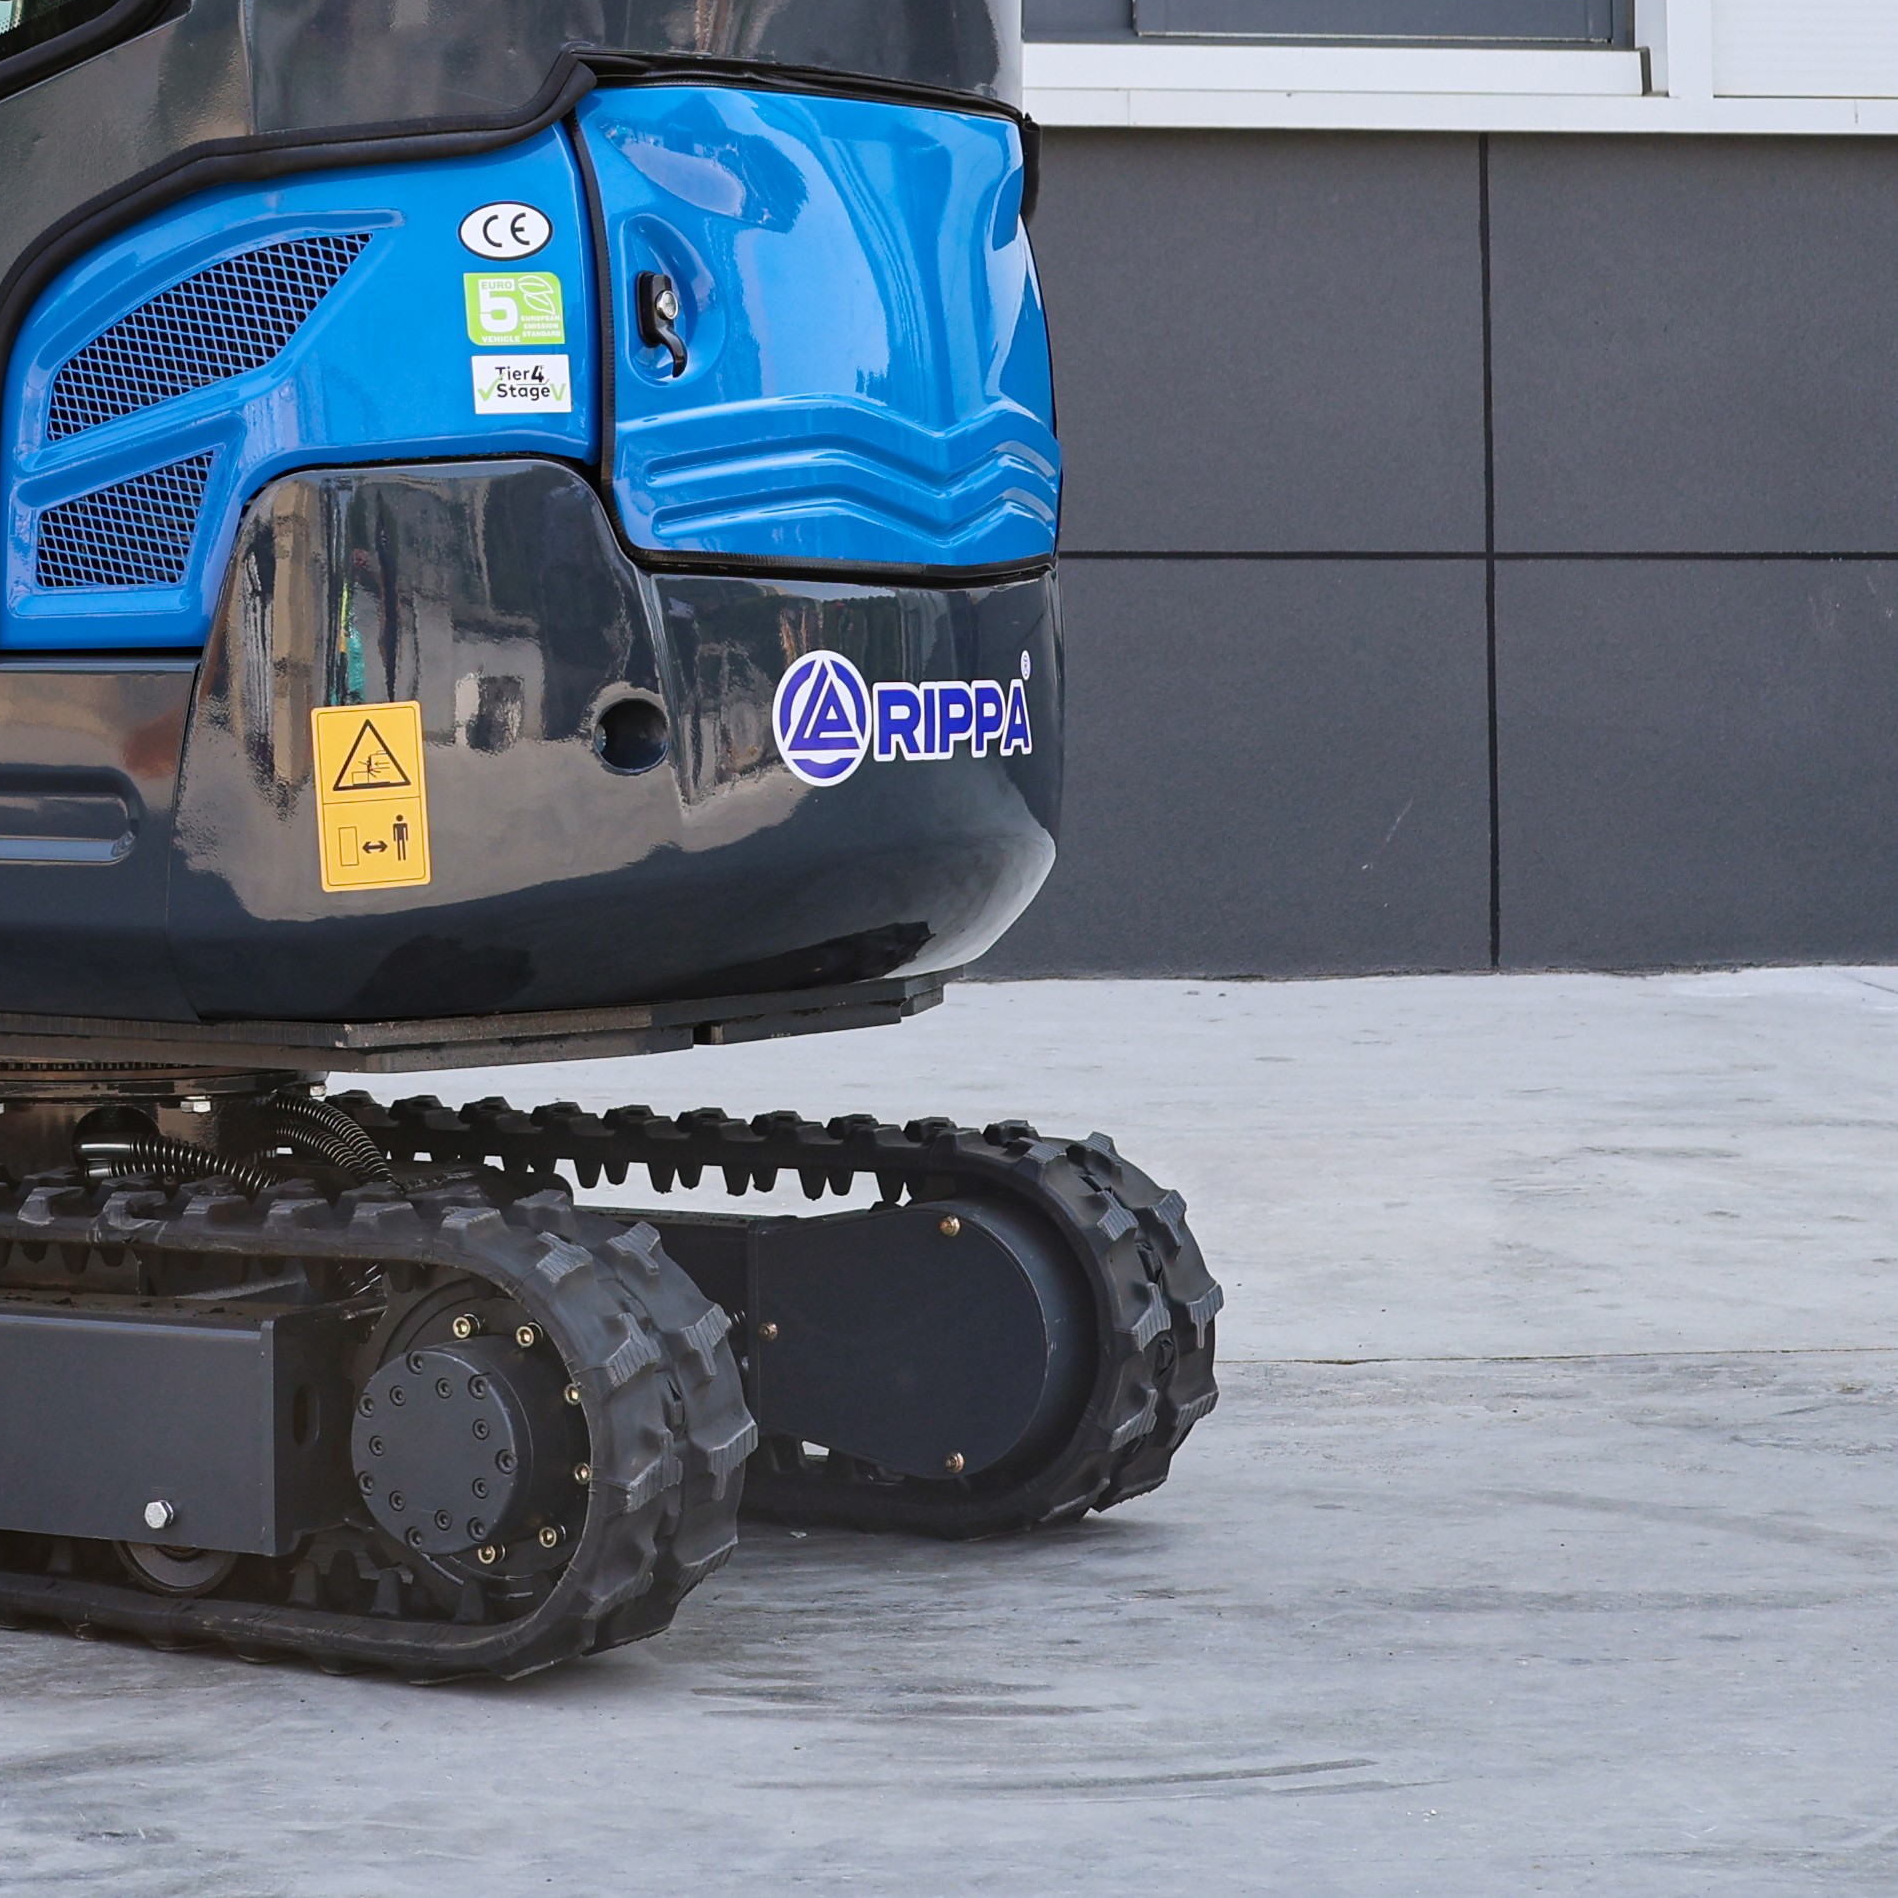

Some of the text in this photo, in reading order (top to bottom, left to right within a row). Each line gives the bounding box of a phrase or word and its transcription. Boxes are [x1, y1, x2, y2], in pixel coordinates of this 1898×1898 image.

[483, 212, 531, 247] CE
[481, 280, 513, 290] EURO
[478, 279, 518, 333] 5
[521, 314, 561, 322] EUROPEAN
[481, 335, 521, 343] VEHICLE
